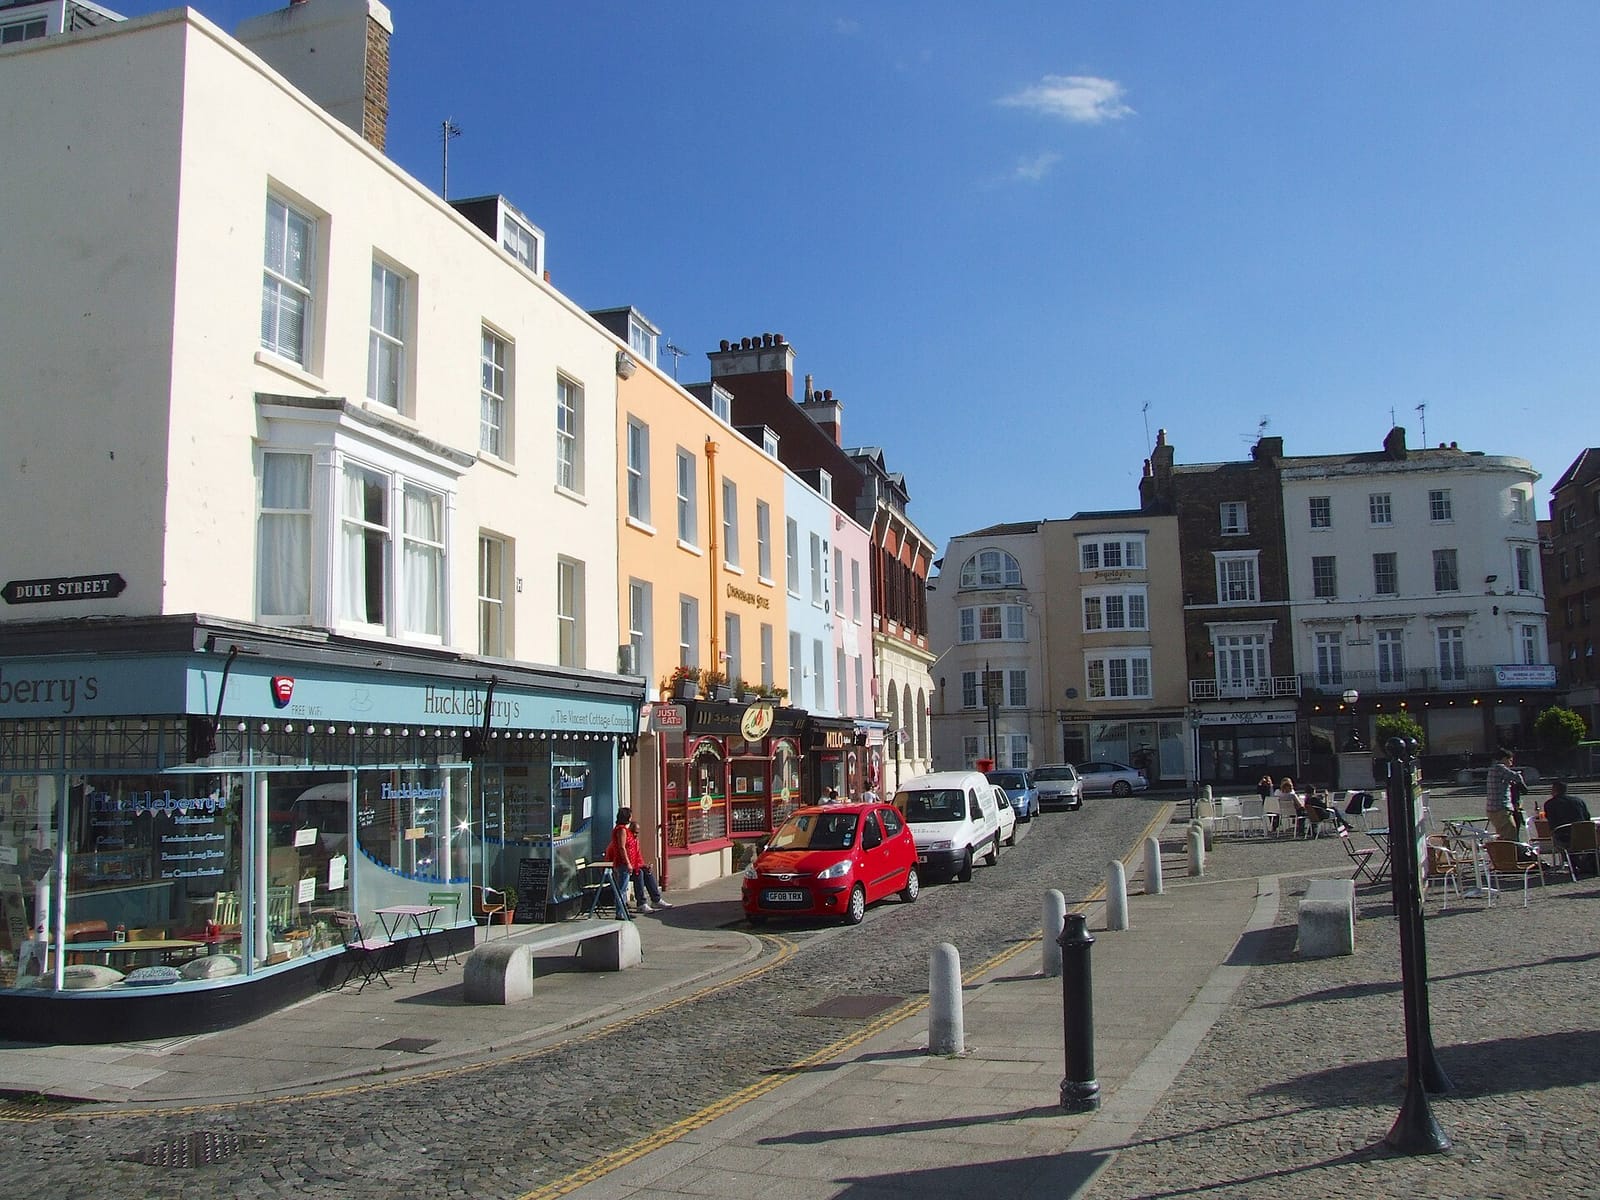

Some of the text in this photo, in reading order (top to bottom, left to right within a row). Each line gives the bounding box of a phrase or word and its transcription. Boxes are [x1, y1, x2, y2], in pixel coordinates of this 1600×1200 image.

[16, 579, 110, 598] DUKE STREET
[292, 704, 305, 716] FREE
[657, 709, 677, 717] JUST
[556, 709, 567, 724] The
[588, 712, 610, 729] Cottage
[825, 730, 842, 748] MILO
[788, 892, 801, 900] TRX
